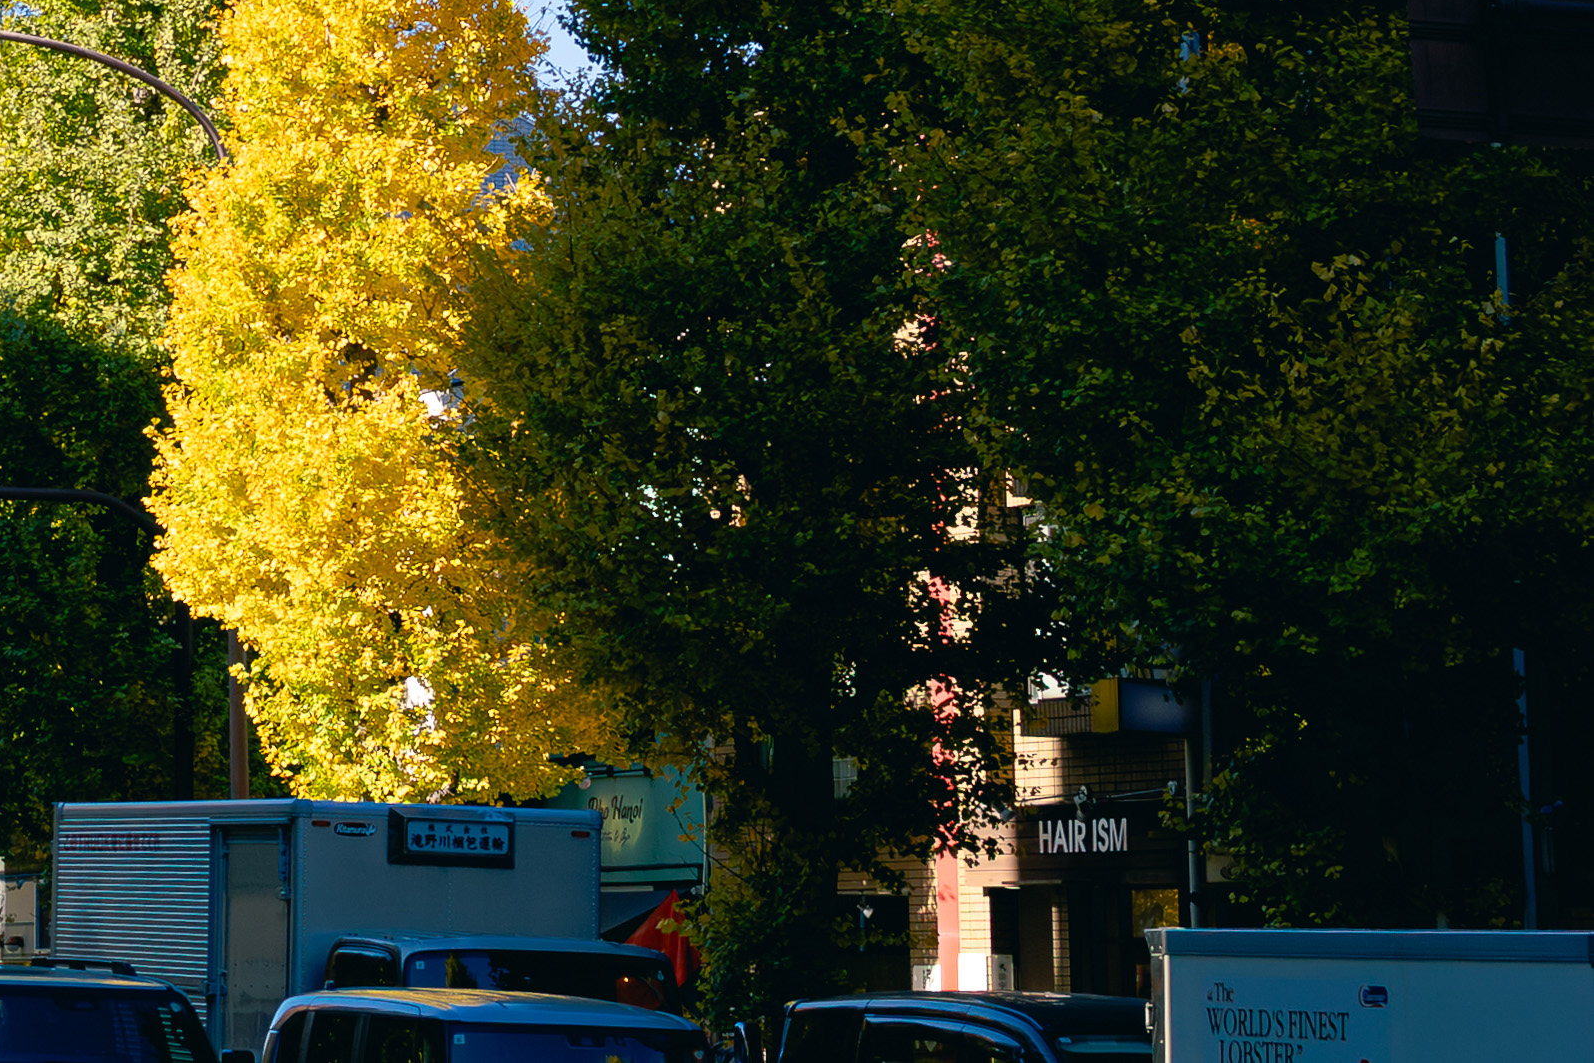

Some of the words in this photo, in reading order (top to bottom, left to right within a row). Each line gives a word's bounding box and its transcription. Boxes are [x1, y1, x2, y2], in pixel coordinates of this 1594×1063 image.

[611, 794, 643, 824] Hanoi
[410, 833, 505, 852] 滝野川梱包運輸
[427, 823, 488, 835] 株式会社
[1038, 819, 1086, 853] HAIR
[1092, 818, 1127, 852] ISM
[1287, 1010, 1349, 1041] FINEST
